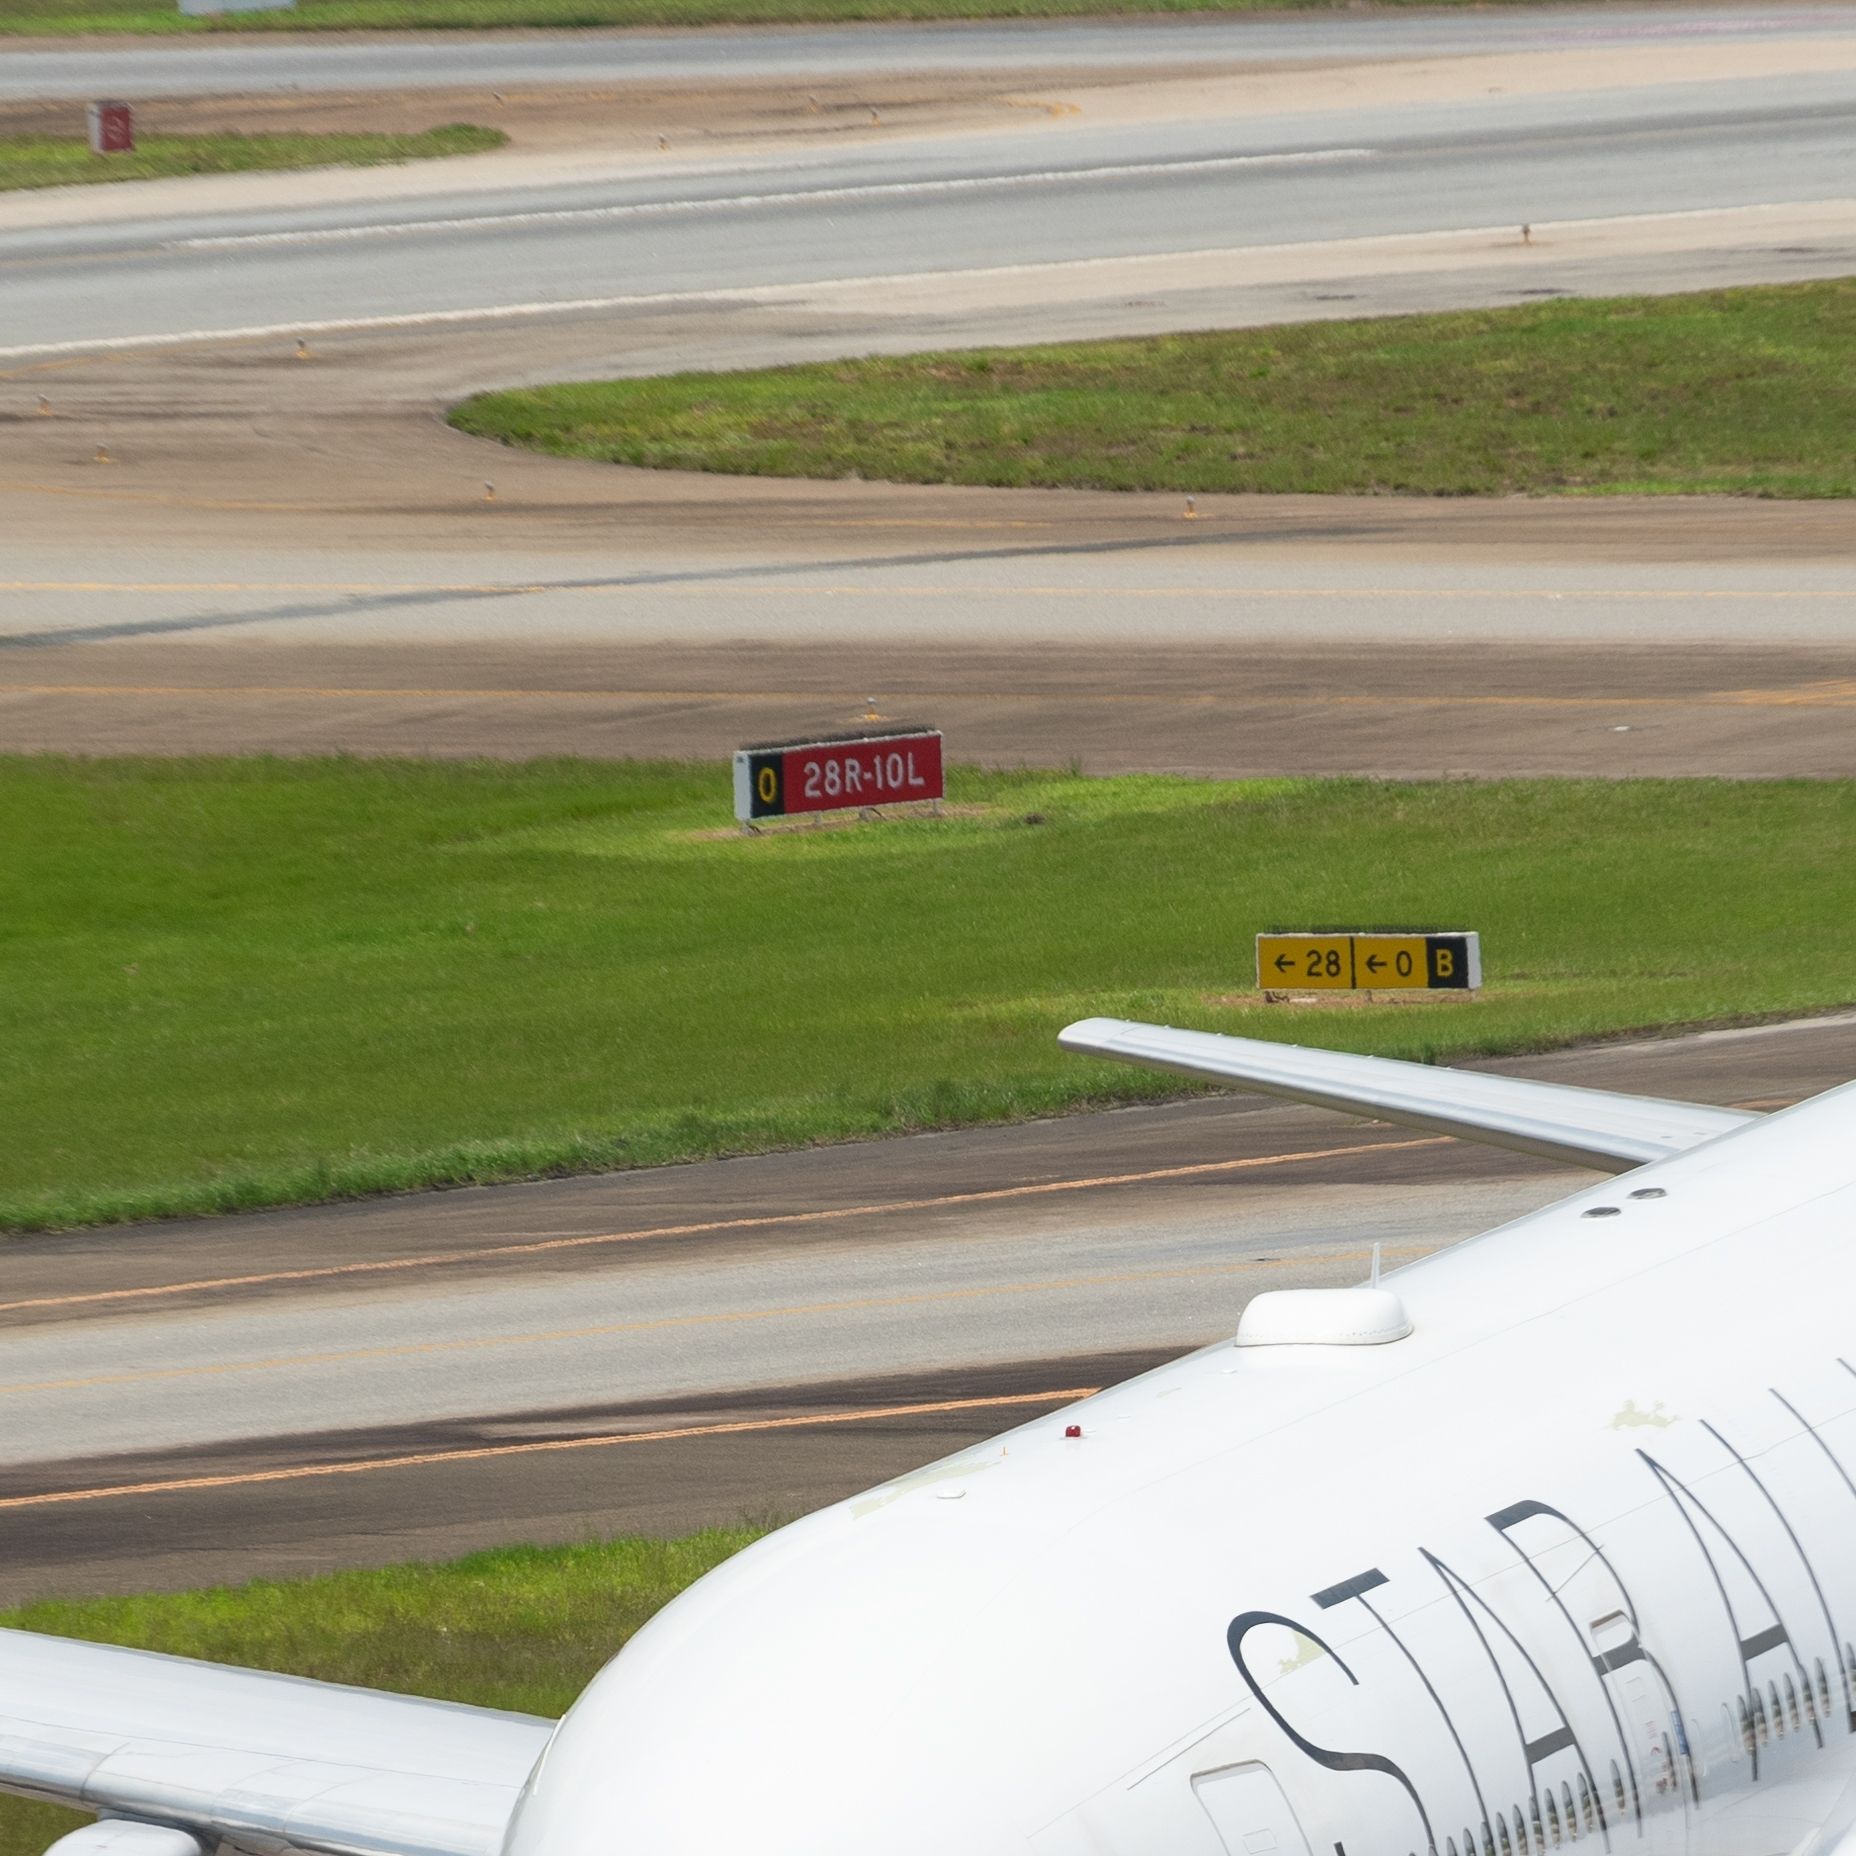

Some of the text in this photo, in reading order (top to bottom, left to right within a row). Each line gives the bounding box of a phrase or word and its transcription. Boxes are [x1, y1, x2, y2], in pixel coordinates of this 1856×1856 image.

[803, 752, 925, 798] 28R-10L
[1306, 950, 1341, 977] 28
[1436, 949, 1453, 977] B
